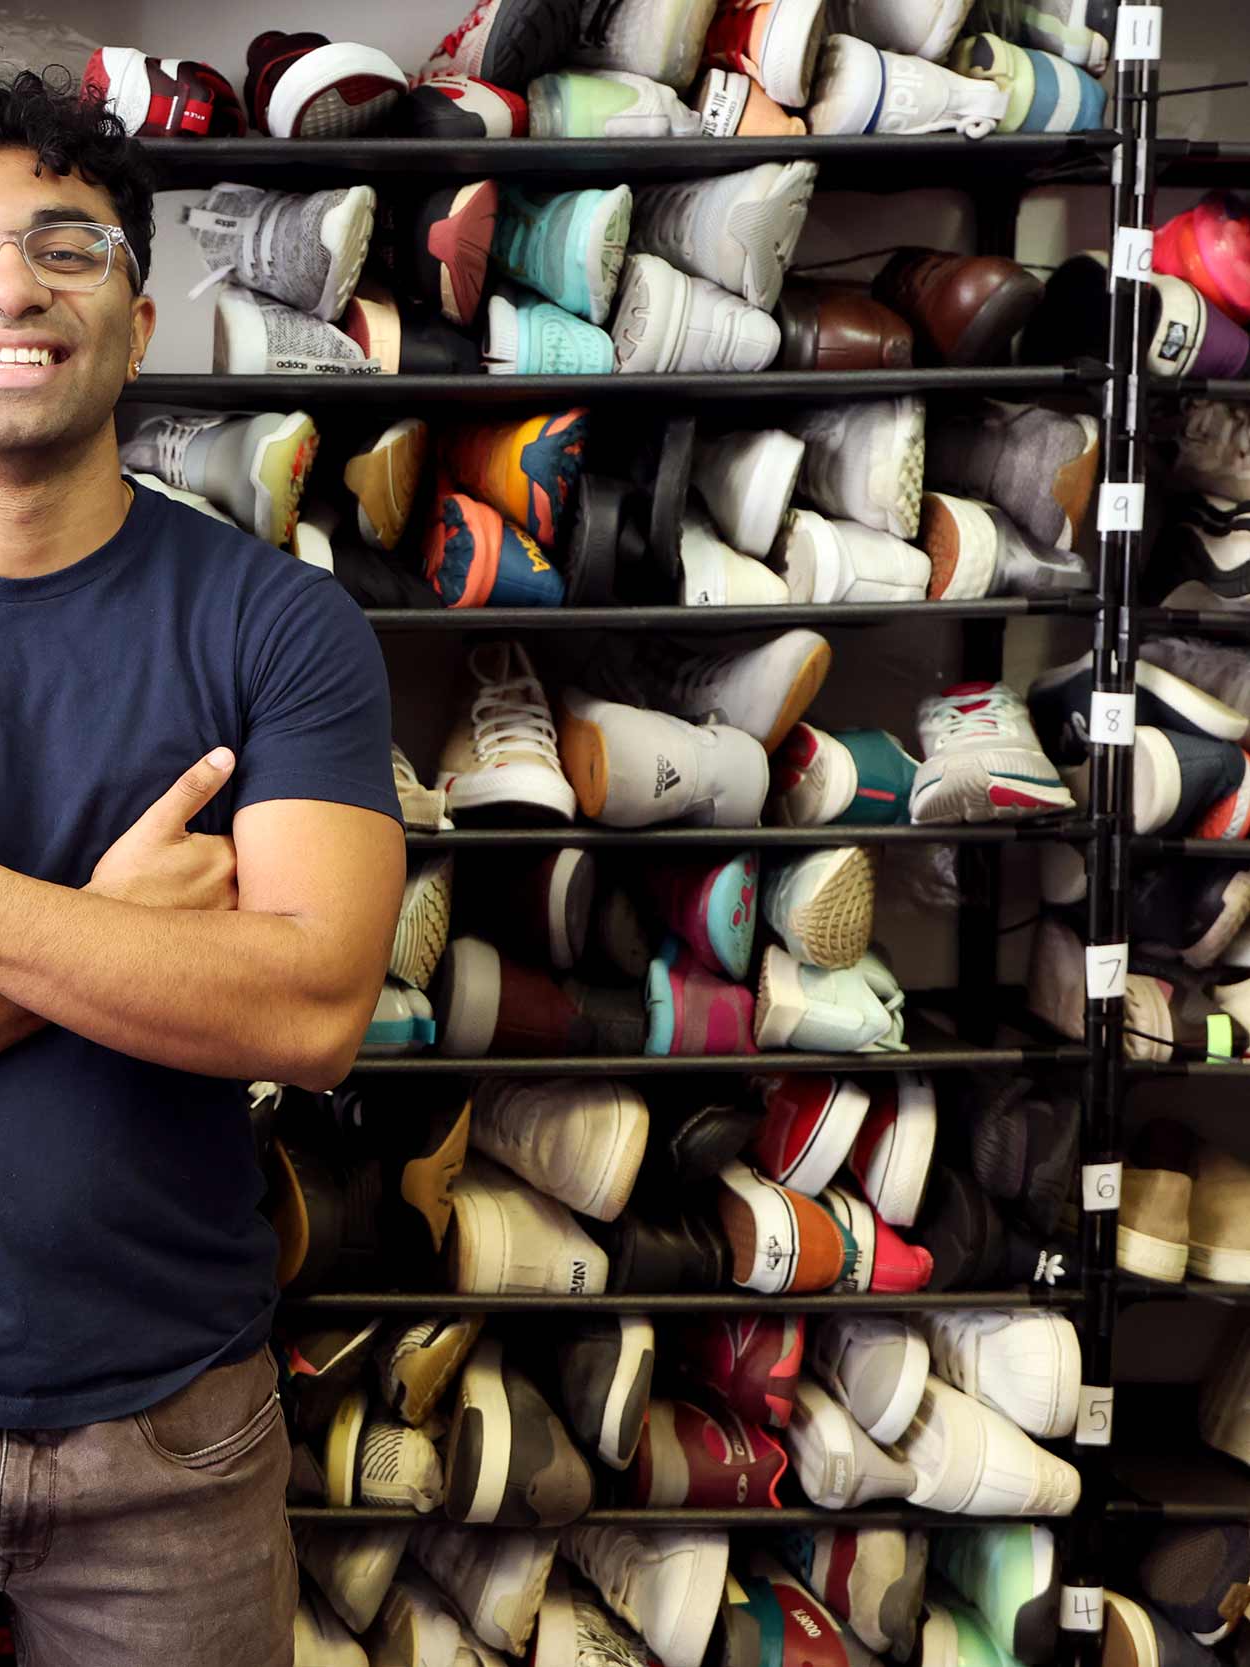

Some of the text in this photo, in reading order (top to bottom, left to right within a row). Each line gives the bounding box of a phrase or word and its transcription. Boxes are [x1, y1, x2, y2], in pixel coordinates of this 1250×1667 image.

[1132, 19, 1153, 47] 11
[1125, 242, 1153, 272] 10
[276, 360, 308, 370] adidas
[314, 362, 346, 375] adidas
[1112, 495, 1130, 524] 9
[1106, 709, 1122, 733] 8
[653, 754, 666, 799] adidas
[1098, 958, 1122, 990] 7
[1096, 1173, 1116, 1199] 6
[570, 1261, 586, 1296] NIK
[1089, 1400, 1112, 1432] 5
[1074, 1594, 1100, 1625] 4
